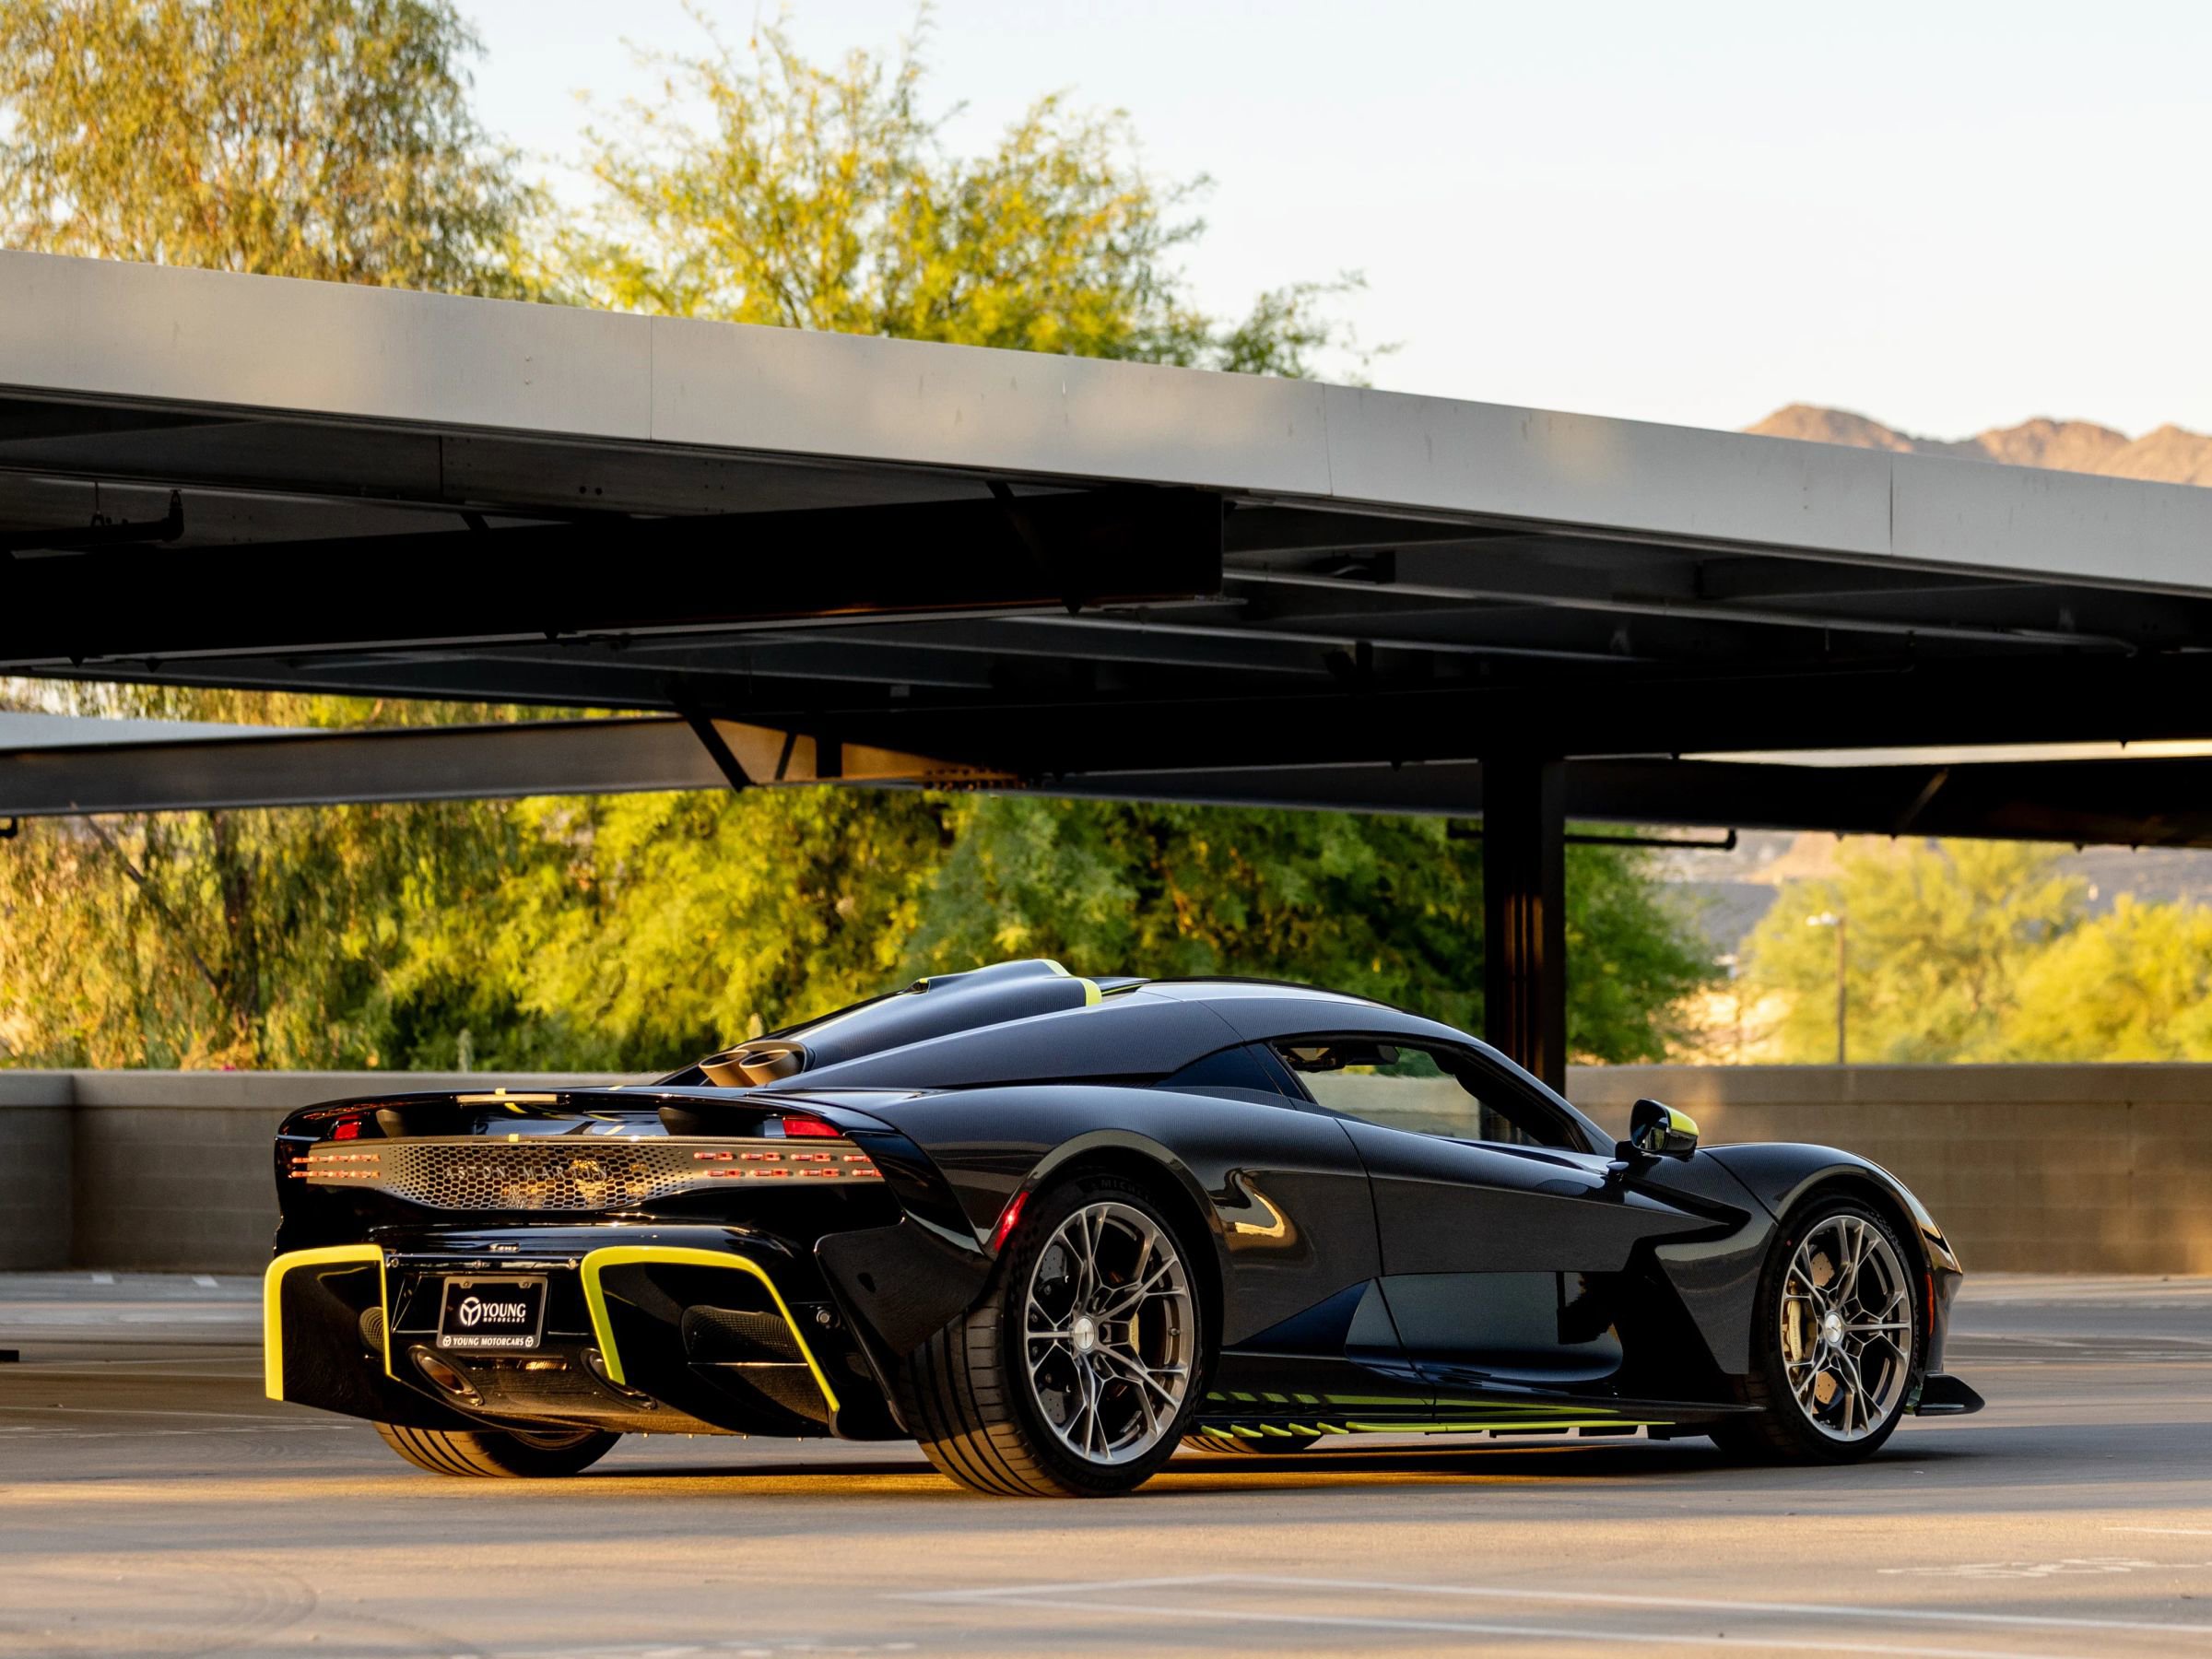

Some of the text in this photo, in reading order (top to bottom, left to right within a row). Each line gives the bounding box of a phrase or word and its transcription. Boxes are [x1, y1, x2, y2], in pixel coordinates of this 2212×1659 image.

[446, 1165, 608, 1180] ASTON MARTIN
[482, 1303, 526, 1318] YOUNG
[453, 1337, 524, 1346] YOUNG MOTORCARS
